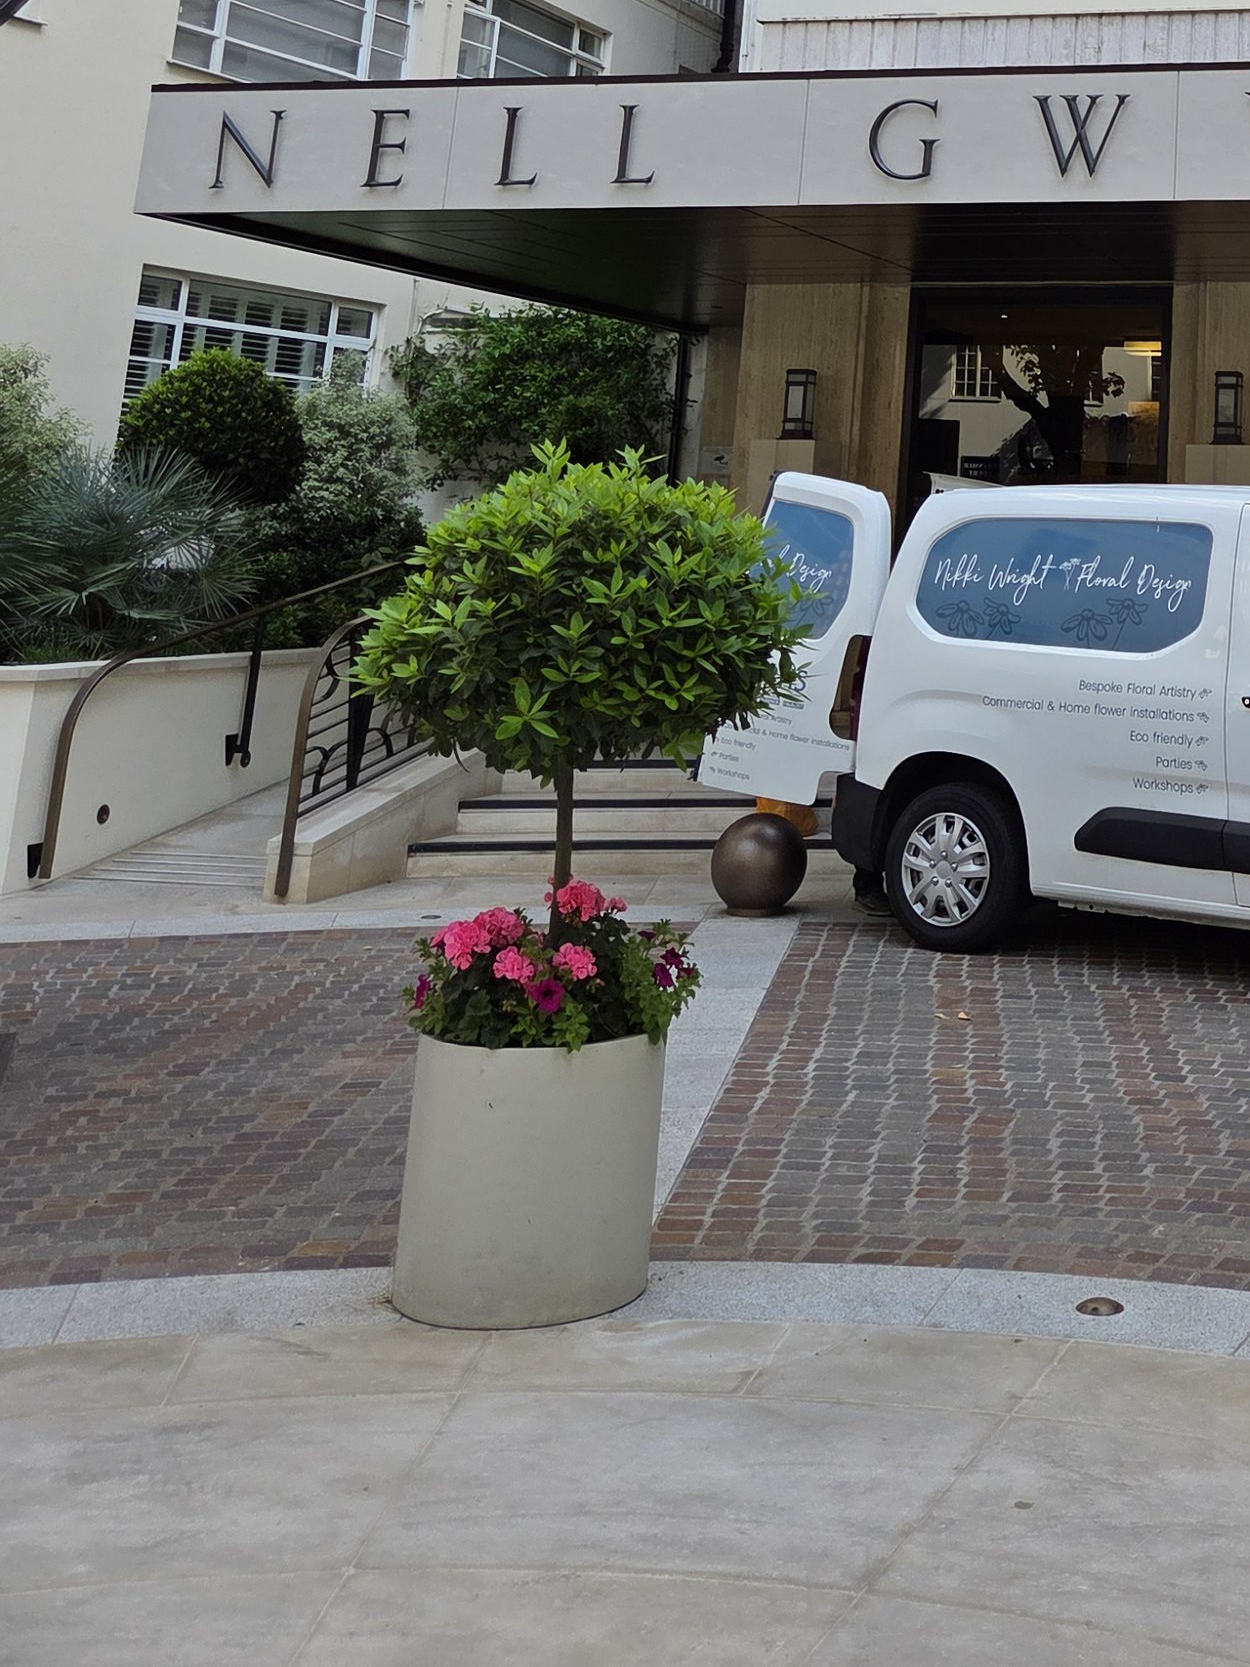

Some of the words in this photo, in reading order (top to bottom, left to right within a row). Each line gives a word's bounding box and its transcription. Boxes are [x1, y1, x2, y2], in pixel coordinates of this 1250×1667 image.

[209, 104, 655, 191] NELL
[935, 553, 985, 591] Nikki
[989, 553, 1057, 606] Wright
[1075, 555, 1135, 593] Floral
[1136, 564, 1192, 612] Design
[1079, 680, 1123, 695] Bespoke
[1126, 682, 1156, 695] Floral
[1159, 685, 1197, 701] Artistry
[982, 696, 1044, 711] Commercial
[1047, 701, 1055, 712] &
[1059, 702, 1090, 714] Home
[1094, 703, 1127, 717] flower
[1130, 706, 1195, 723] installations
[1130, 730, 1149, 743] Eco
[1153, 731, 1194, 749] friendly
[1155, 756, 1193, 770] Parties
[1133, 777, 1194, 795] Workshops
